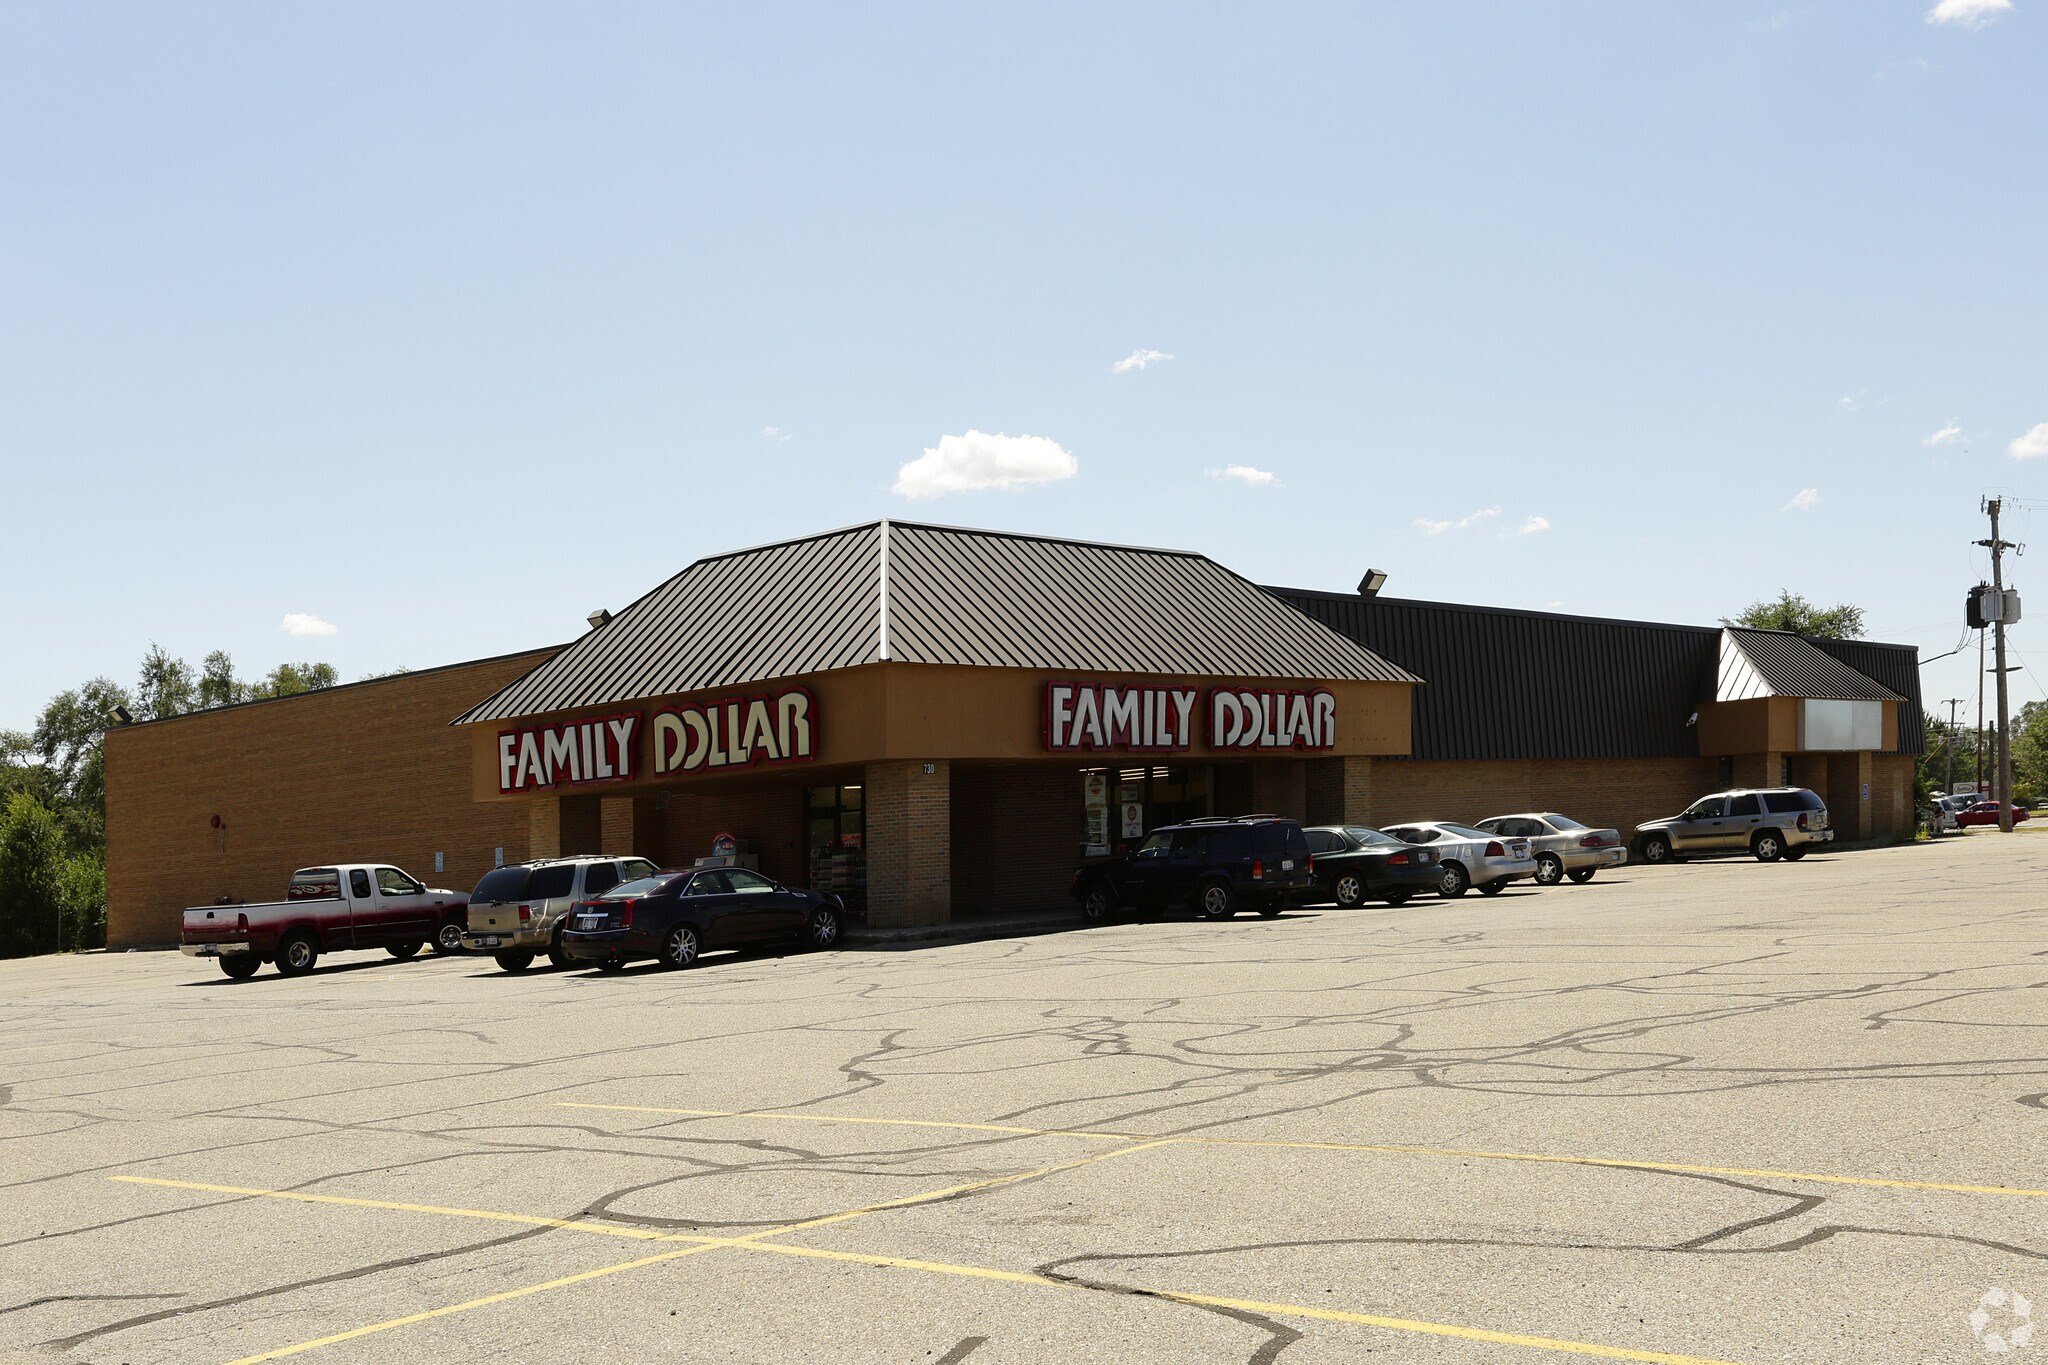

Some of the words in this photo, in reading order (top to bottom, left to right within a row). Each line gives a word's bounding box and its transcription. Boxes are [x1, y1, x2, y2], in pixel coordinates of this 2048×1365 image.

[500, 717, 635, 789] FAMILY
[653, 693, 811, 774] DOLLAR
[1051, 687, 1197, 746] FAMILY
[1214, 692, 1336, 746] DOLLAR
[923, 763, 935, 774] 730
